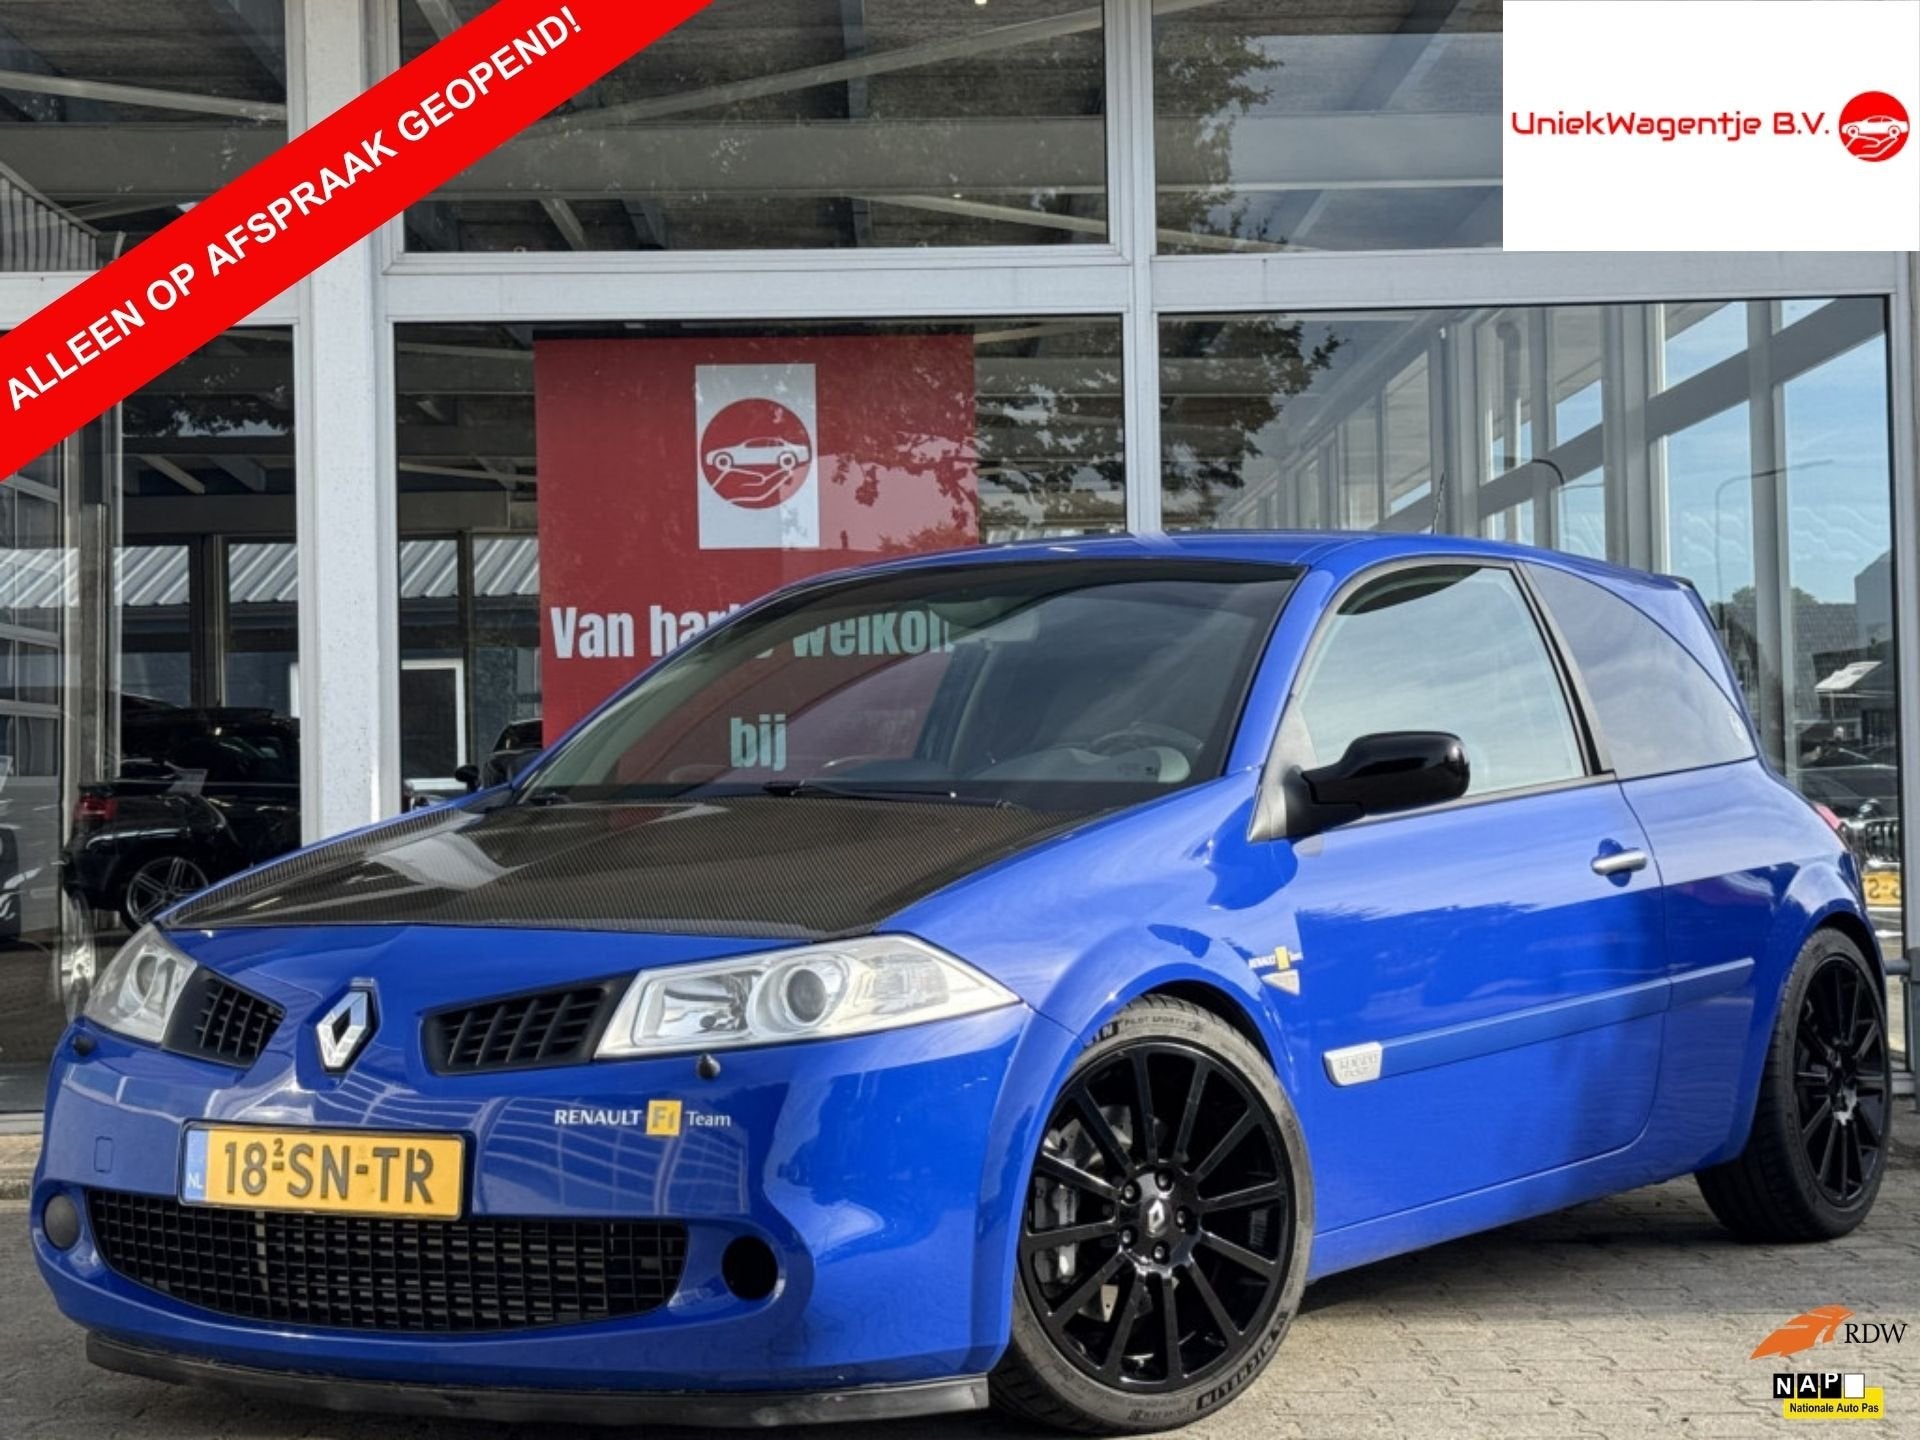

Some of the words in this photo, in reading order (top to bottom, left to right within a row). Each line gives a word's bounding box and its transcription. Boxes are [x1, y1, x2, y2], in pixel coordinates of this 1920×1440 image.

[551, 606, 634, 659] Van
[731, 714, 787, 771] bij
[554, 1109, 642, 1126] RENAULT
[686, 1111, 731, 1127] Team
